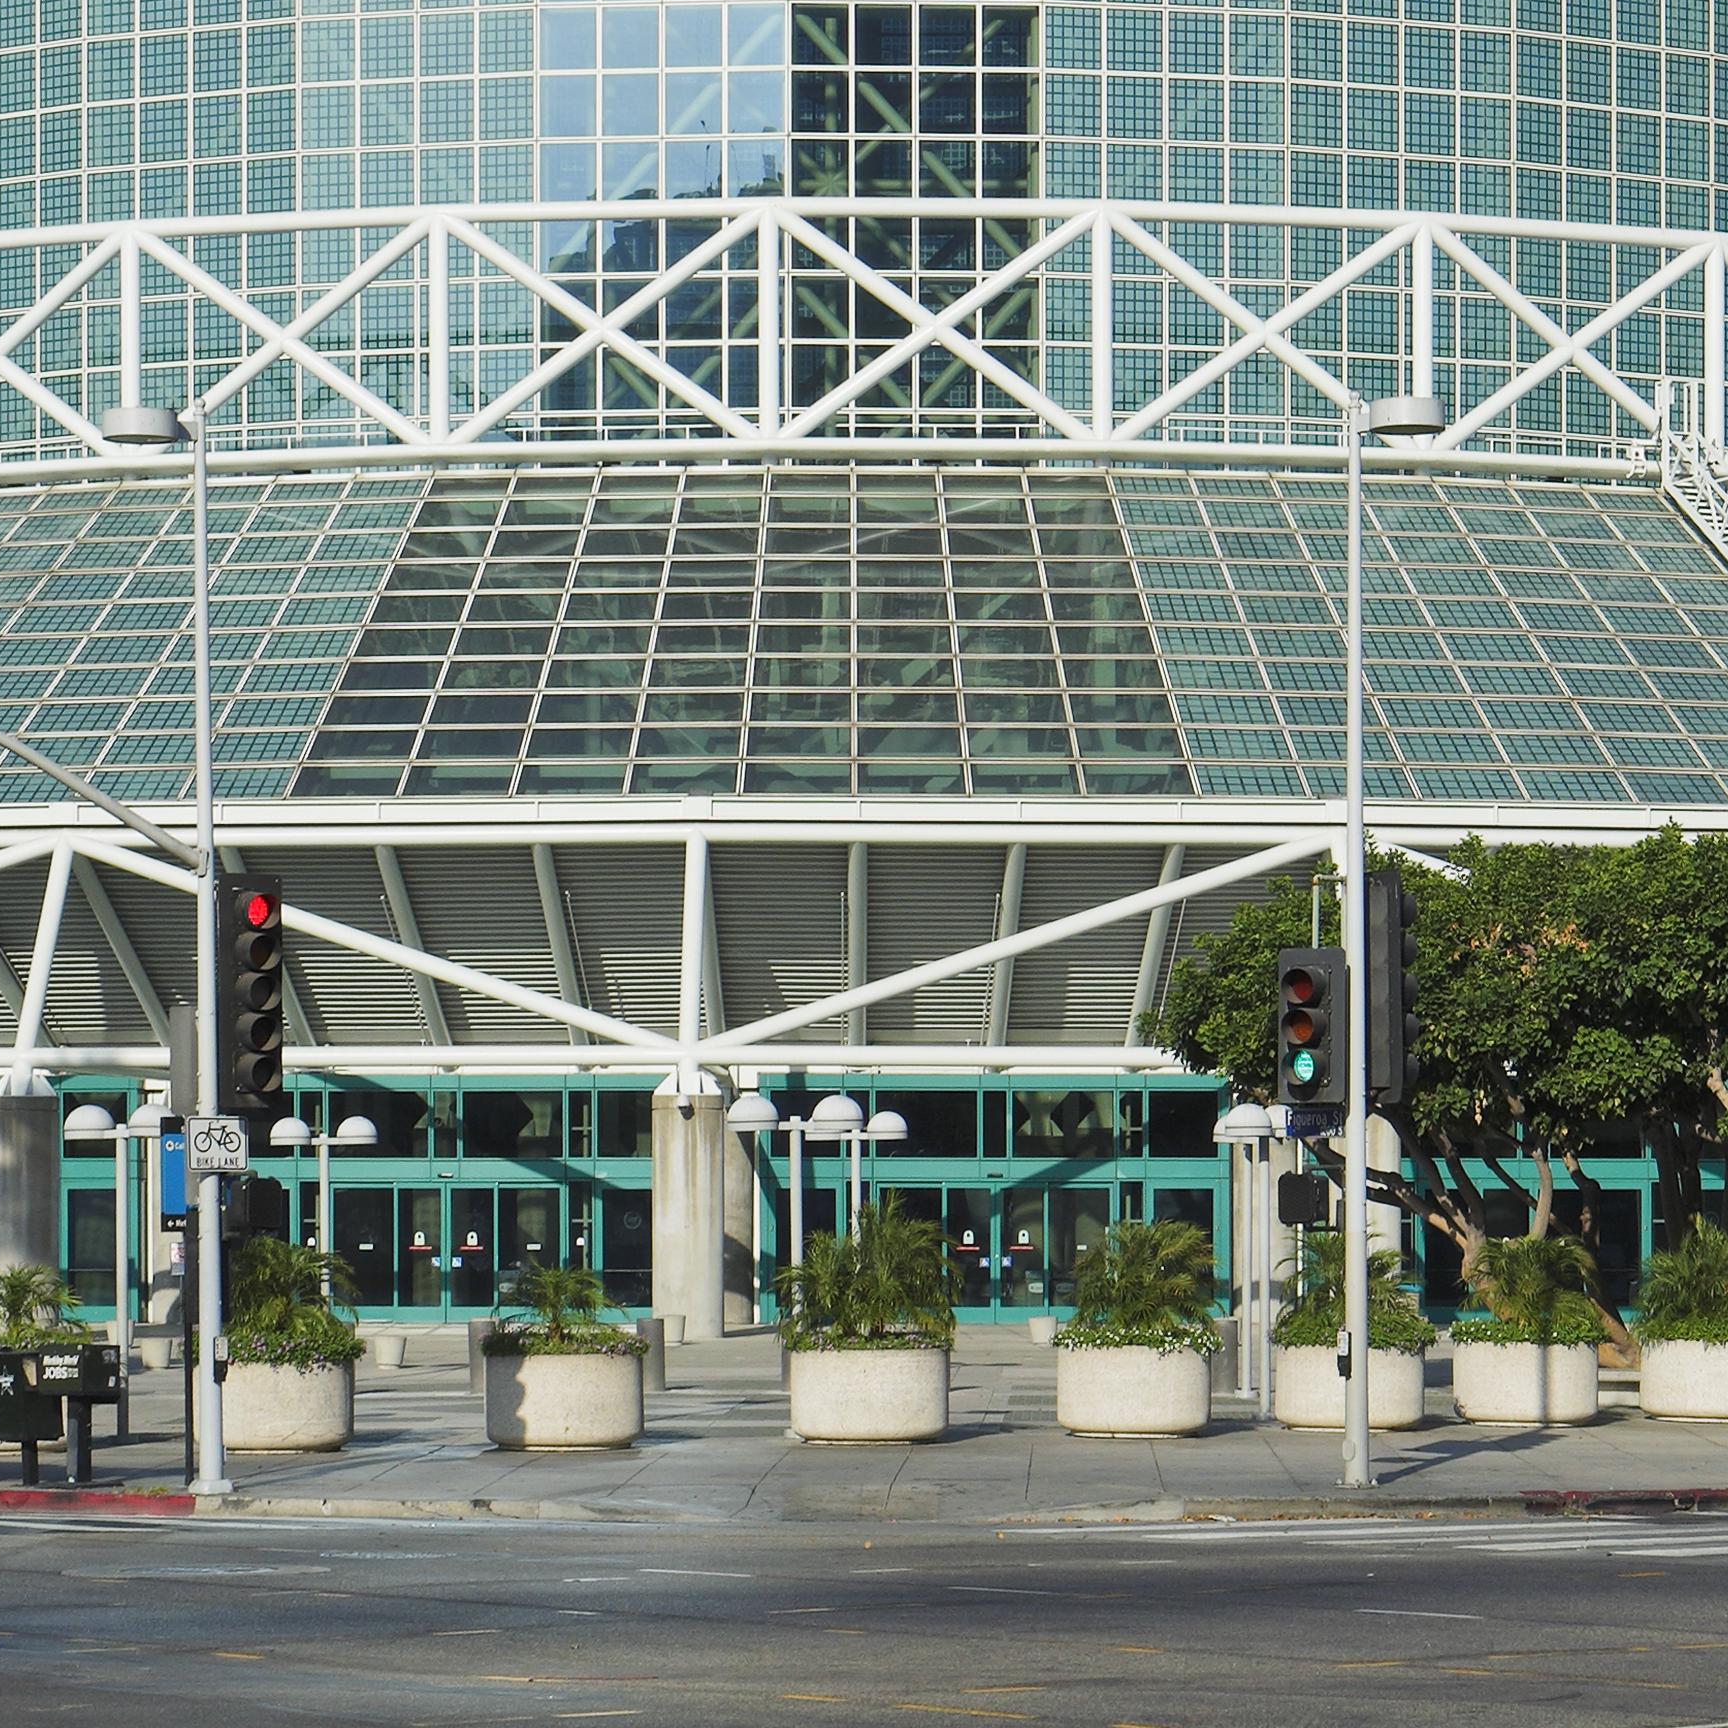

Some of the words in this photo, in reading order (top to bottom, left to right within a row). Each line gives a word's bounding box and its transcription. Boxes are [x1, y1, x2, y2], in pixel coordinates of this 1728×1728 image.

[196, 1157, 215, 1168] BIKE
[217, 1157, 240, 1168] LANE
[43, 1367, 68, 1380] JOBS
